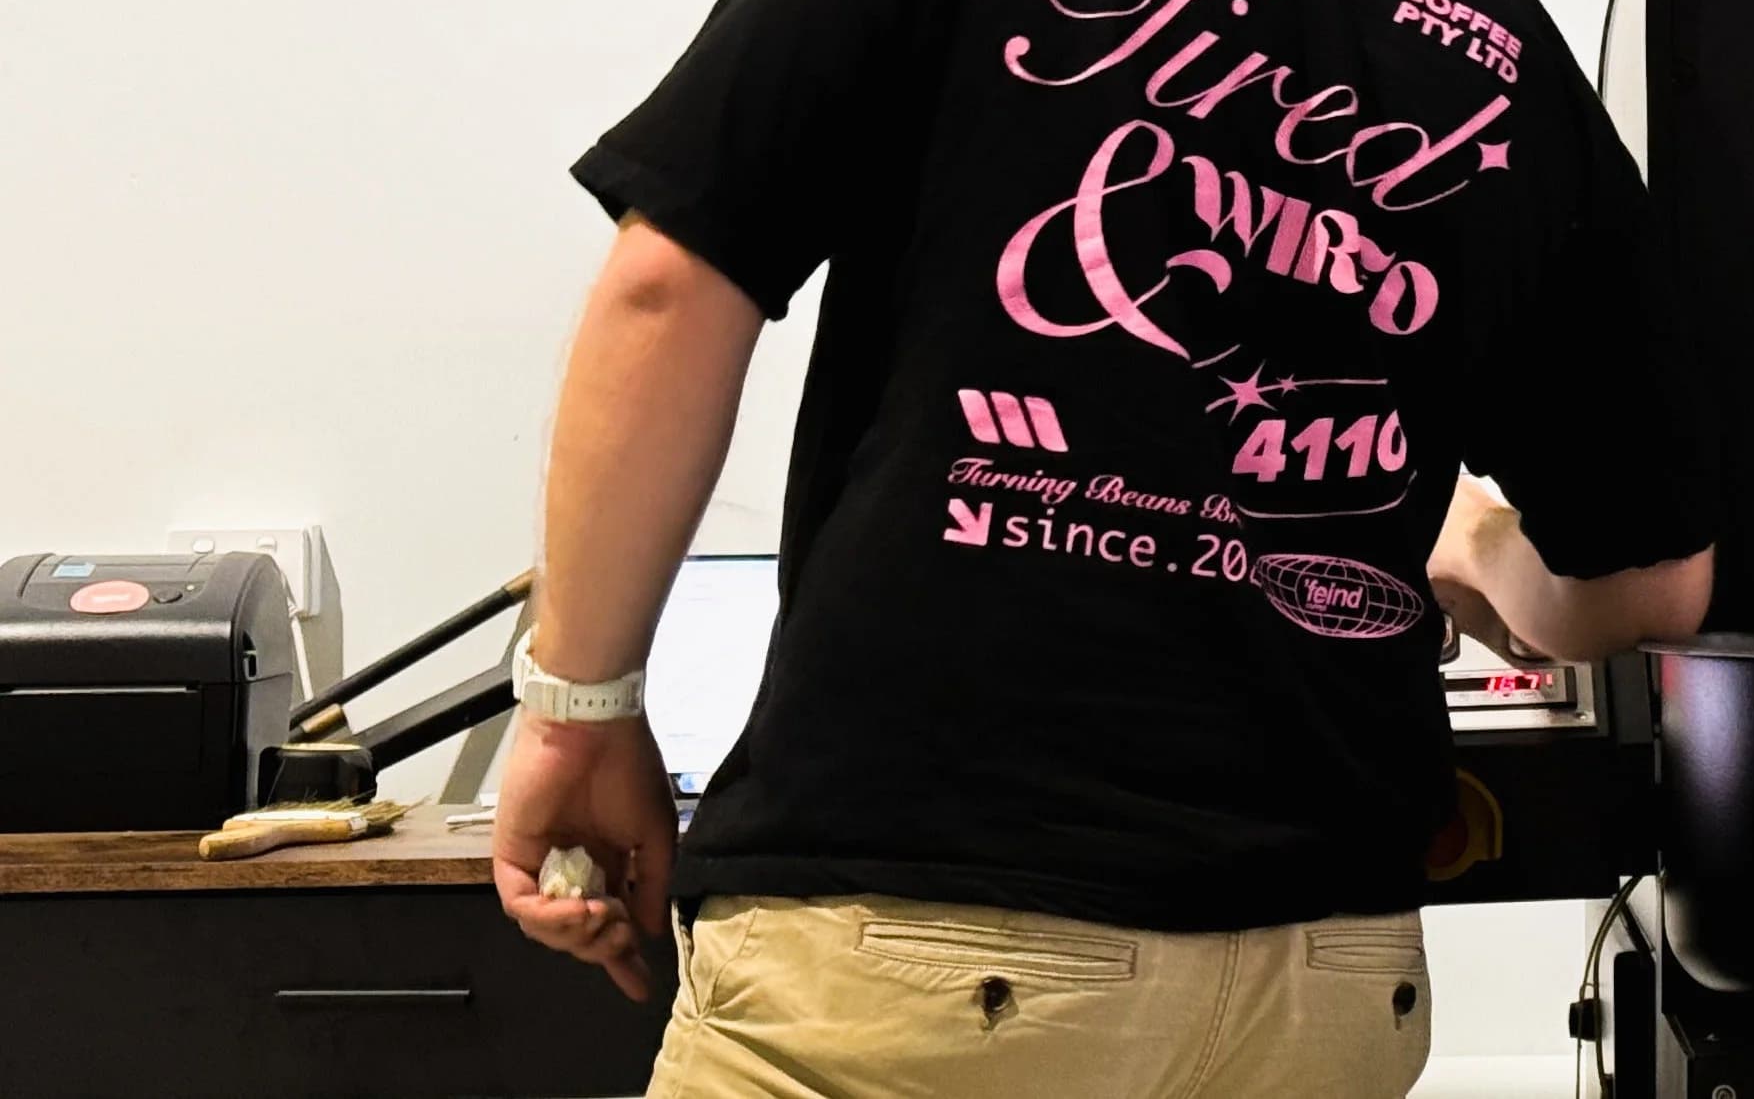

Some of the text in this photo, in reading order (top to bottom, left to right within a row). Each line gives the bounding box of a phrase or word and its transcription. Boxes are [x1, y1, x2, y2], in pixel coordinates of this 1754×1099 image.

[1392, 0, 1519, 84] PTY LTD
[995, 118, 1240, 368] &
[1231, 409, 1408, 483] 4110
[947, 457, 1078, 505] Turning
[1084, 474, 1192, 515] Beans
